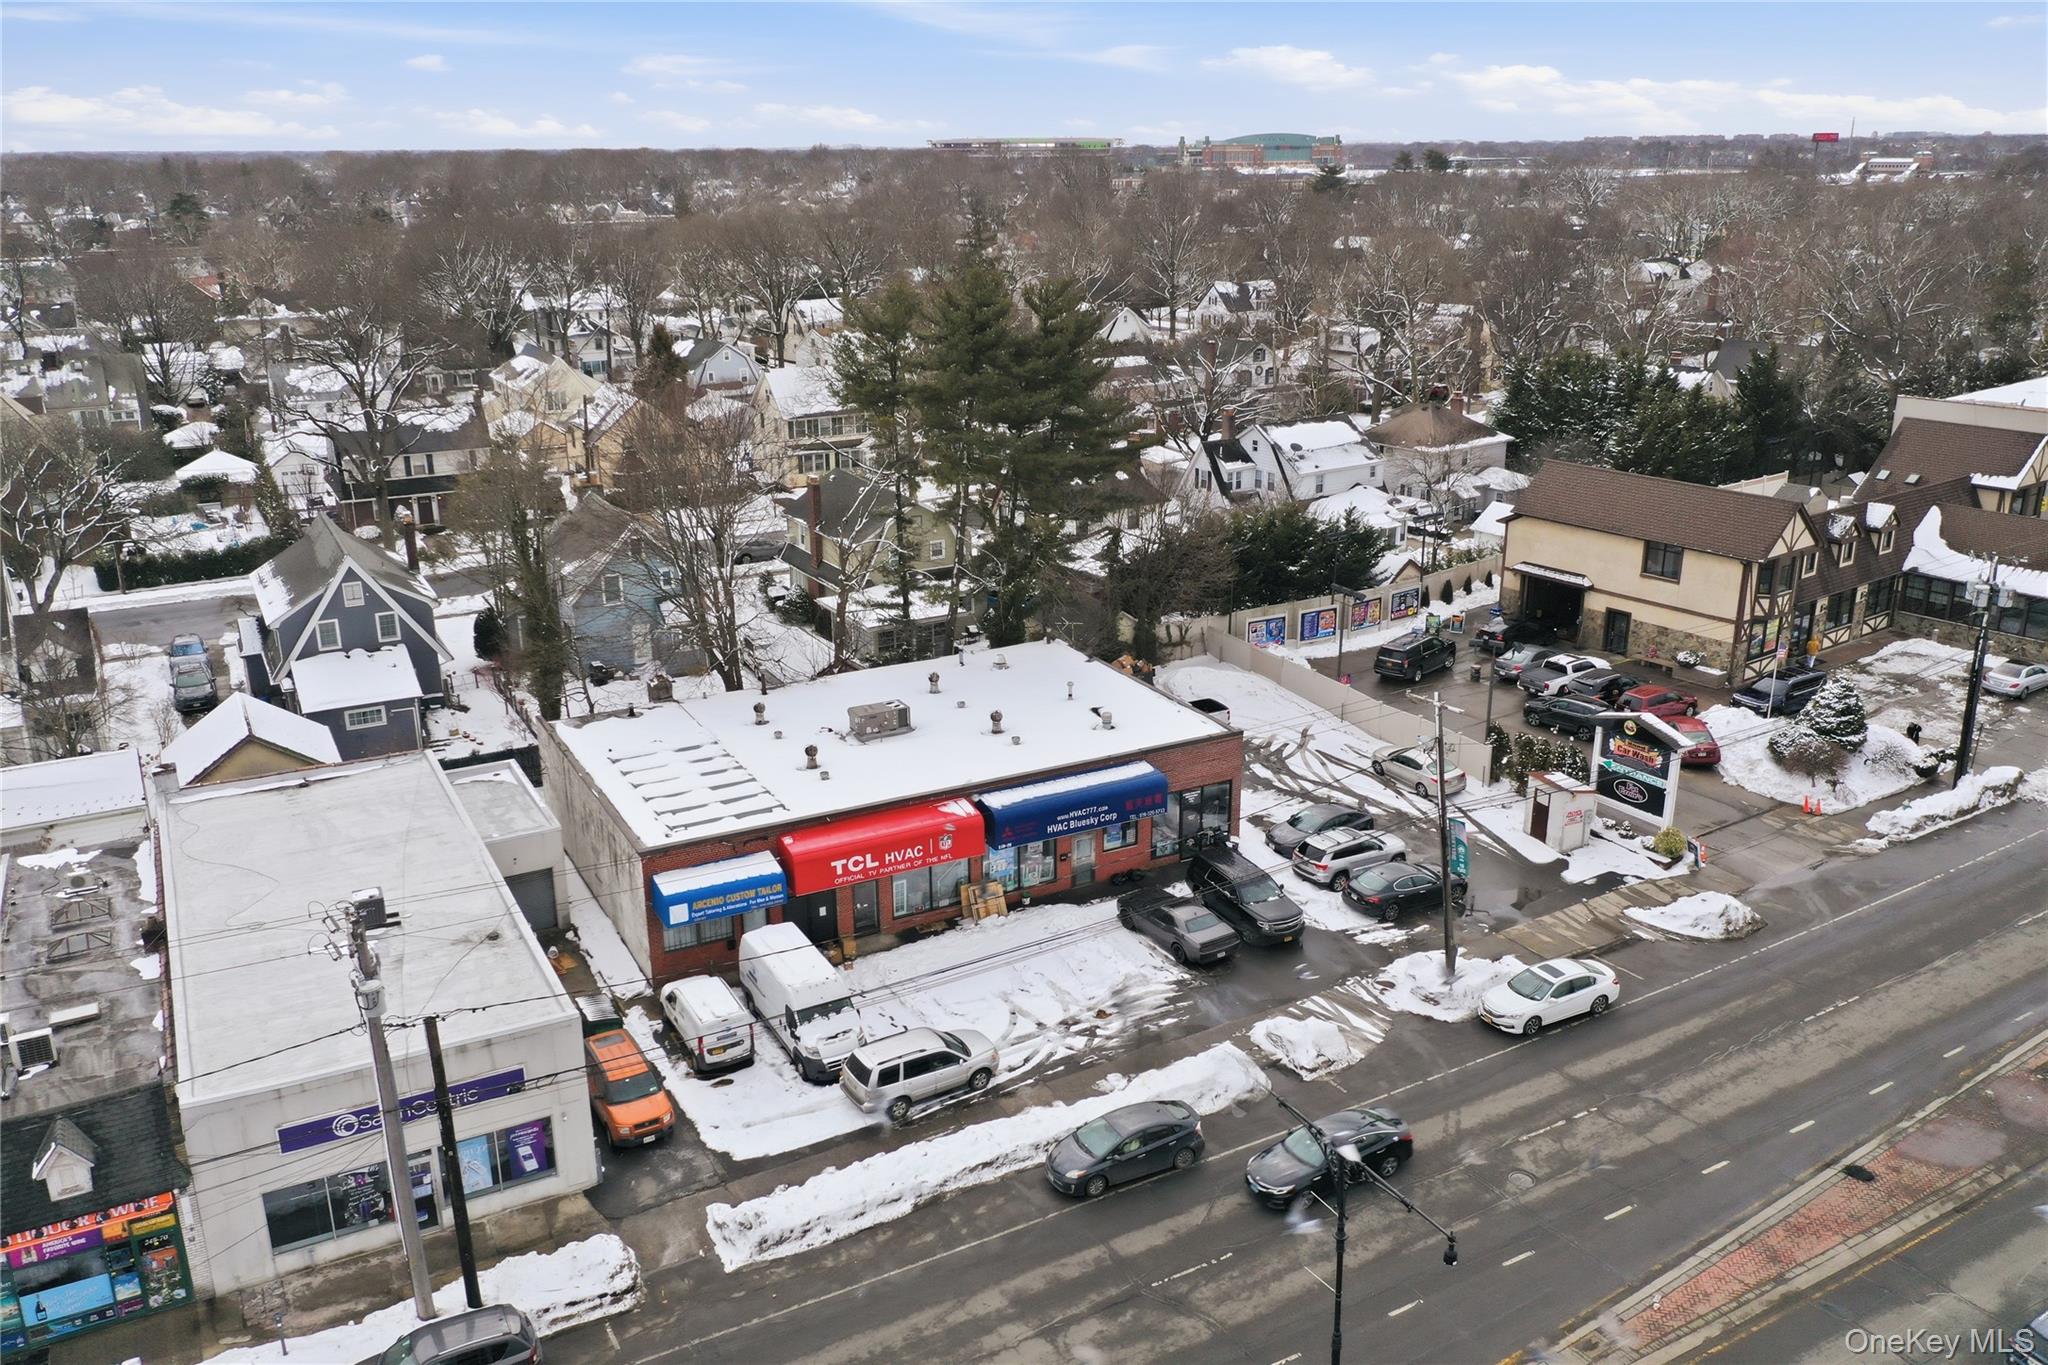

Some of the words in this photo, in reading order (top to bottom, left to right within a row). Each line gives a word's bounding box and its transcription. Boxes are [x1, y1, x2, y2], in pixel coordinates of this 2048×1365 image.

[1617, 745, 1630, 755] Car
[1632, 750, 1654, 764] Wash
[1047, 821, 1068, 834] HVAC
[1069, 814, 1098, 829] Bluesky
[1099, 812, 1118, 823] Corp
[831, 853, 879, 875] TCL
[885, 845, 924, 865] HVAC
[834, 874, 865, 885] OFFICIAL
[880, 863, 911, 874] PARTNER
[926, 855, 939, 863] THE
[726, 889, 756, 903] CUSTOM
[758, 883, 783, 896] TAILOR
